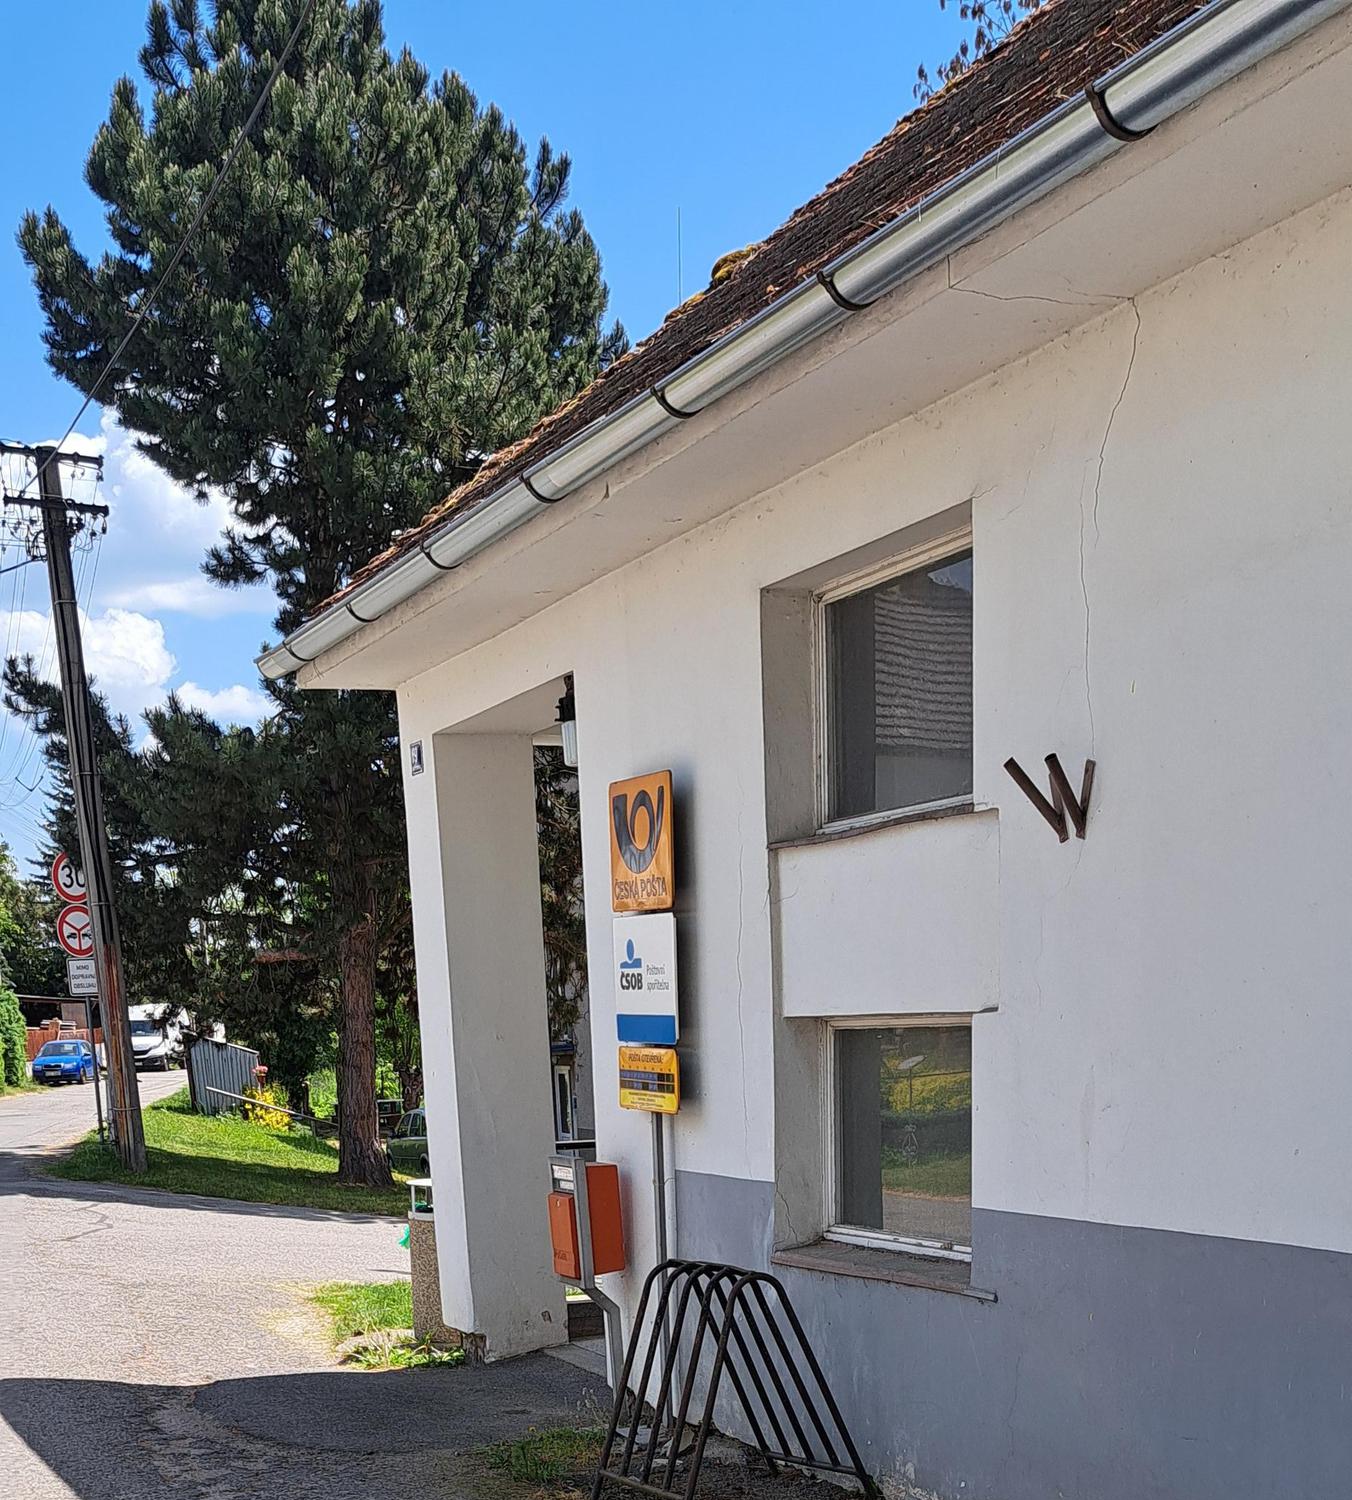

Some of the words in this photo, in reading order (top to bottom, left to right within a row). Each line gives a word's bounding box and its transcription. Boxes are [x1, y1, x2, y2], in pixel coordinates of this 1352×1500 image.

[61, 864, 86, 888] 30
[614, 876, 639, 900] ČESKÁ
[640, 874, 667, 898] POŠTA
[620, 970, 643, 990] ČSOB
